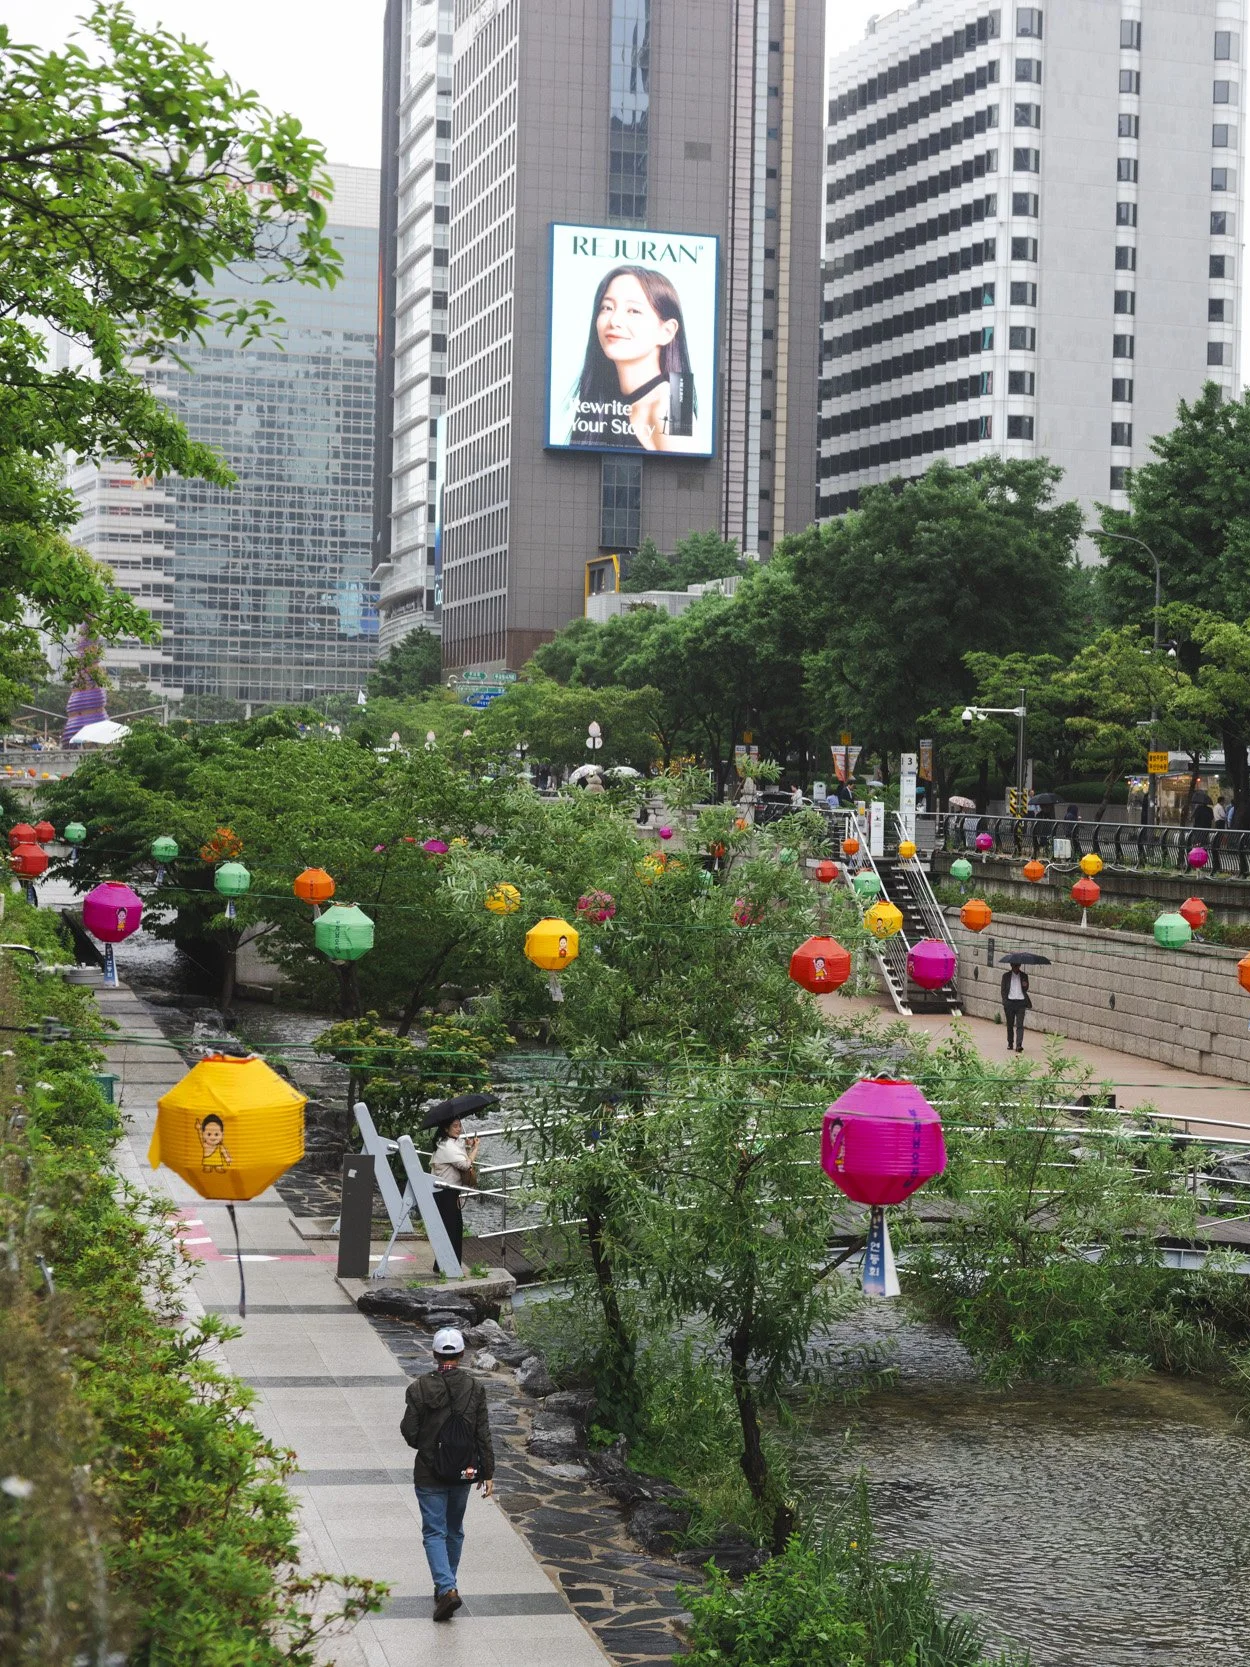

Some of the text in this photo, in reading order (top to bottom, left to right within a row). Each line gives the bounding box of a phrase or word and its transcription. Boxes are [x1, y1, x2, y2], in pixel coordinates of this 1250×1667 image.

[572, 235, 698, 264] REJURAN
[572, 417, 656, 438] Your Stoy
[907, 757, 913, 766] 3
